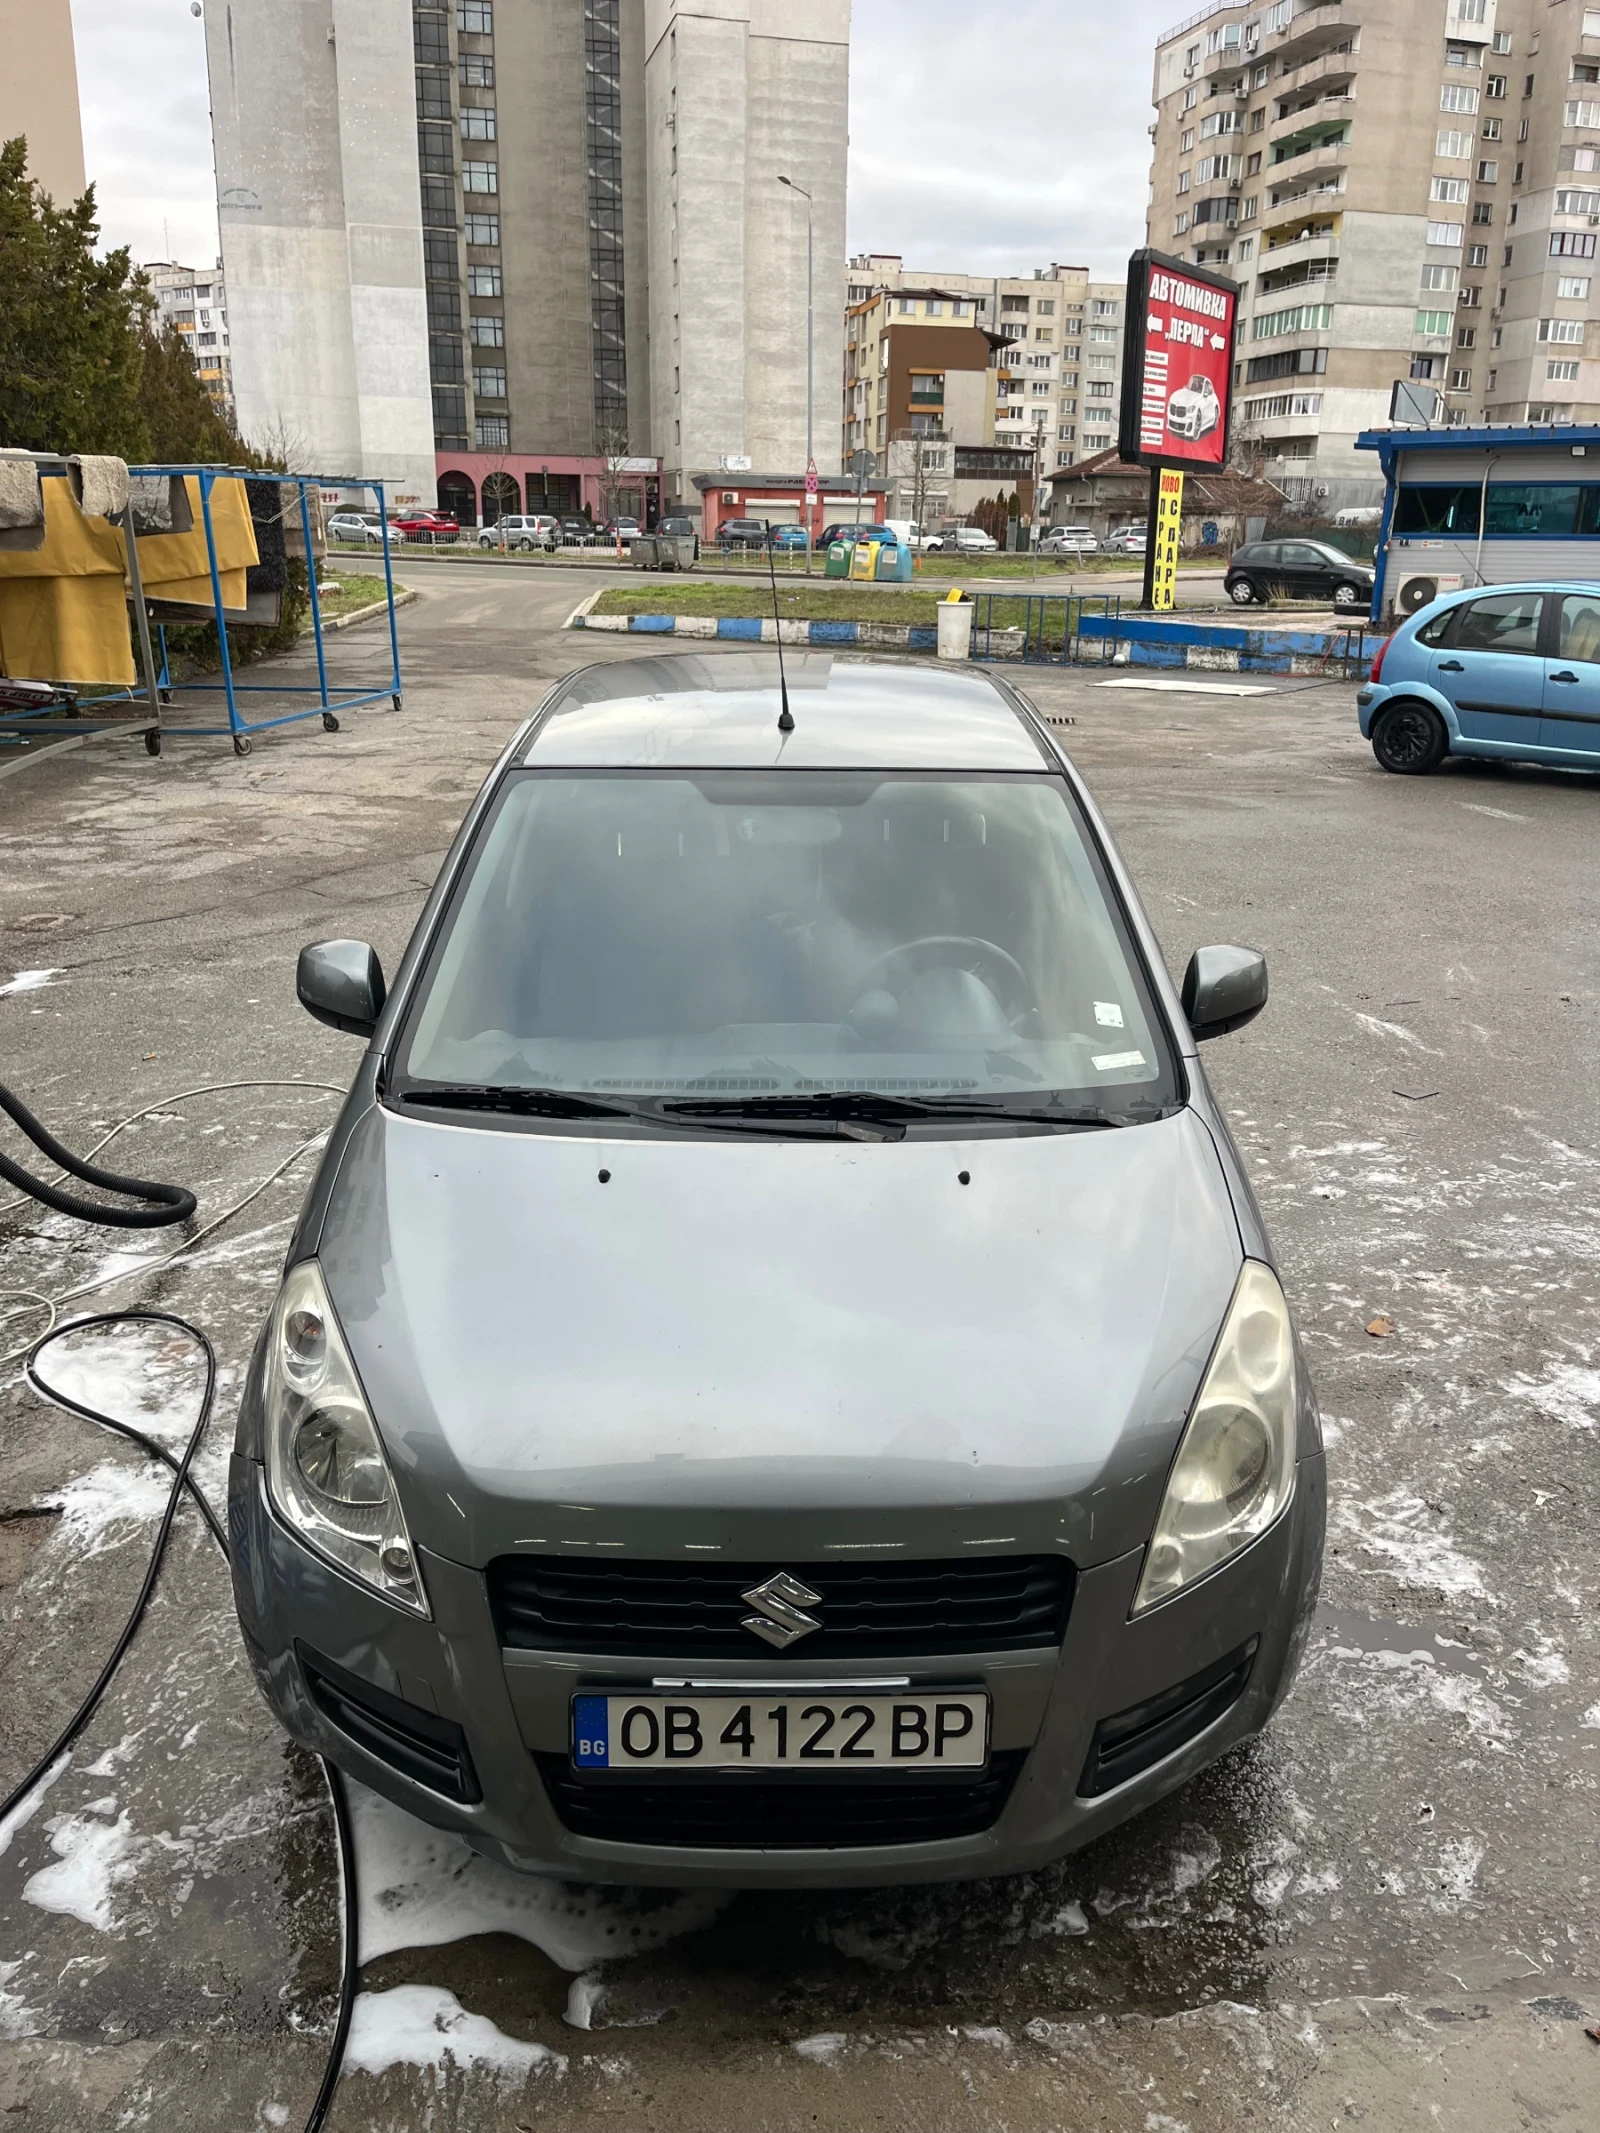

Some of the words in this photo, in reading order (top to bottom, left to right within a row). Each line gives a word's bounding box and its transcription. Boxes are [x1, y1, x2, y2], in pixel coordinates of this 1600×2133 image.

[1149, 272, 1227, 321] АВТОМИВКА
[579, 1739, 606, 1756] BG
[719, 1704, 876, 1759] 4122
